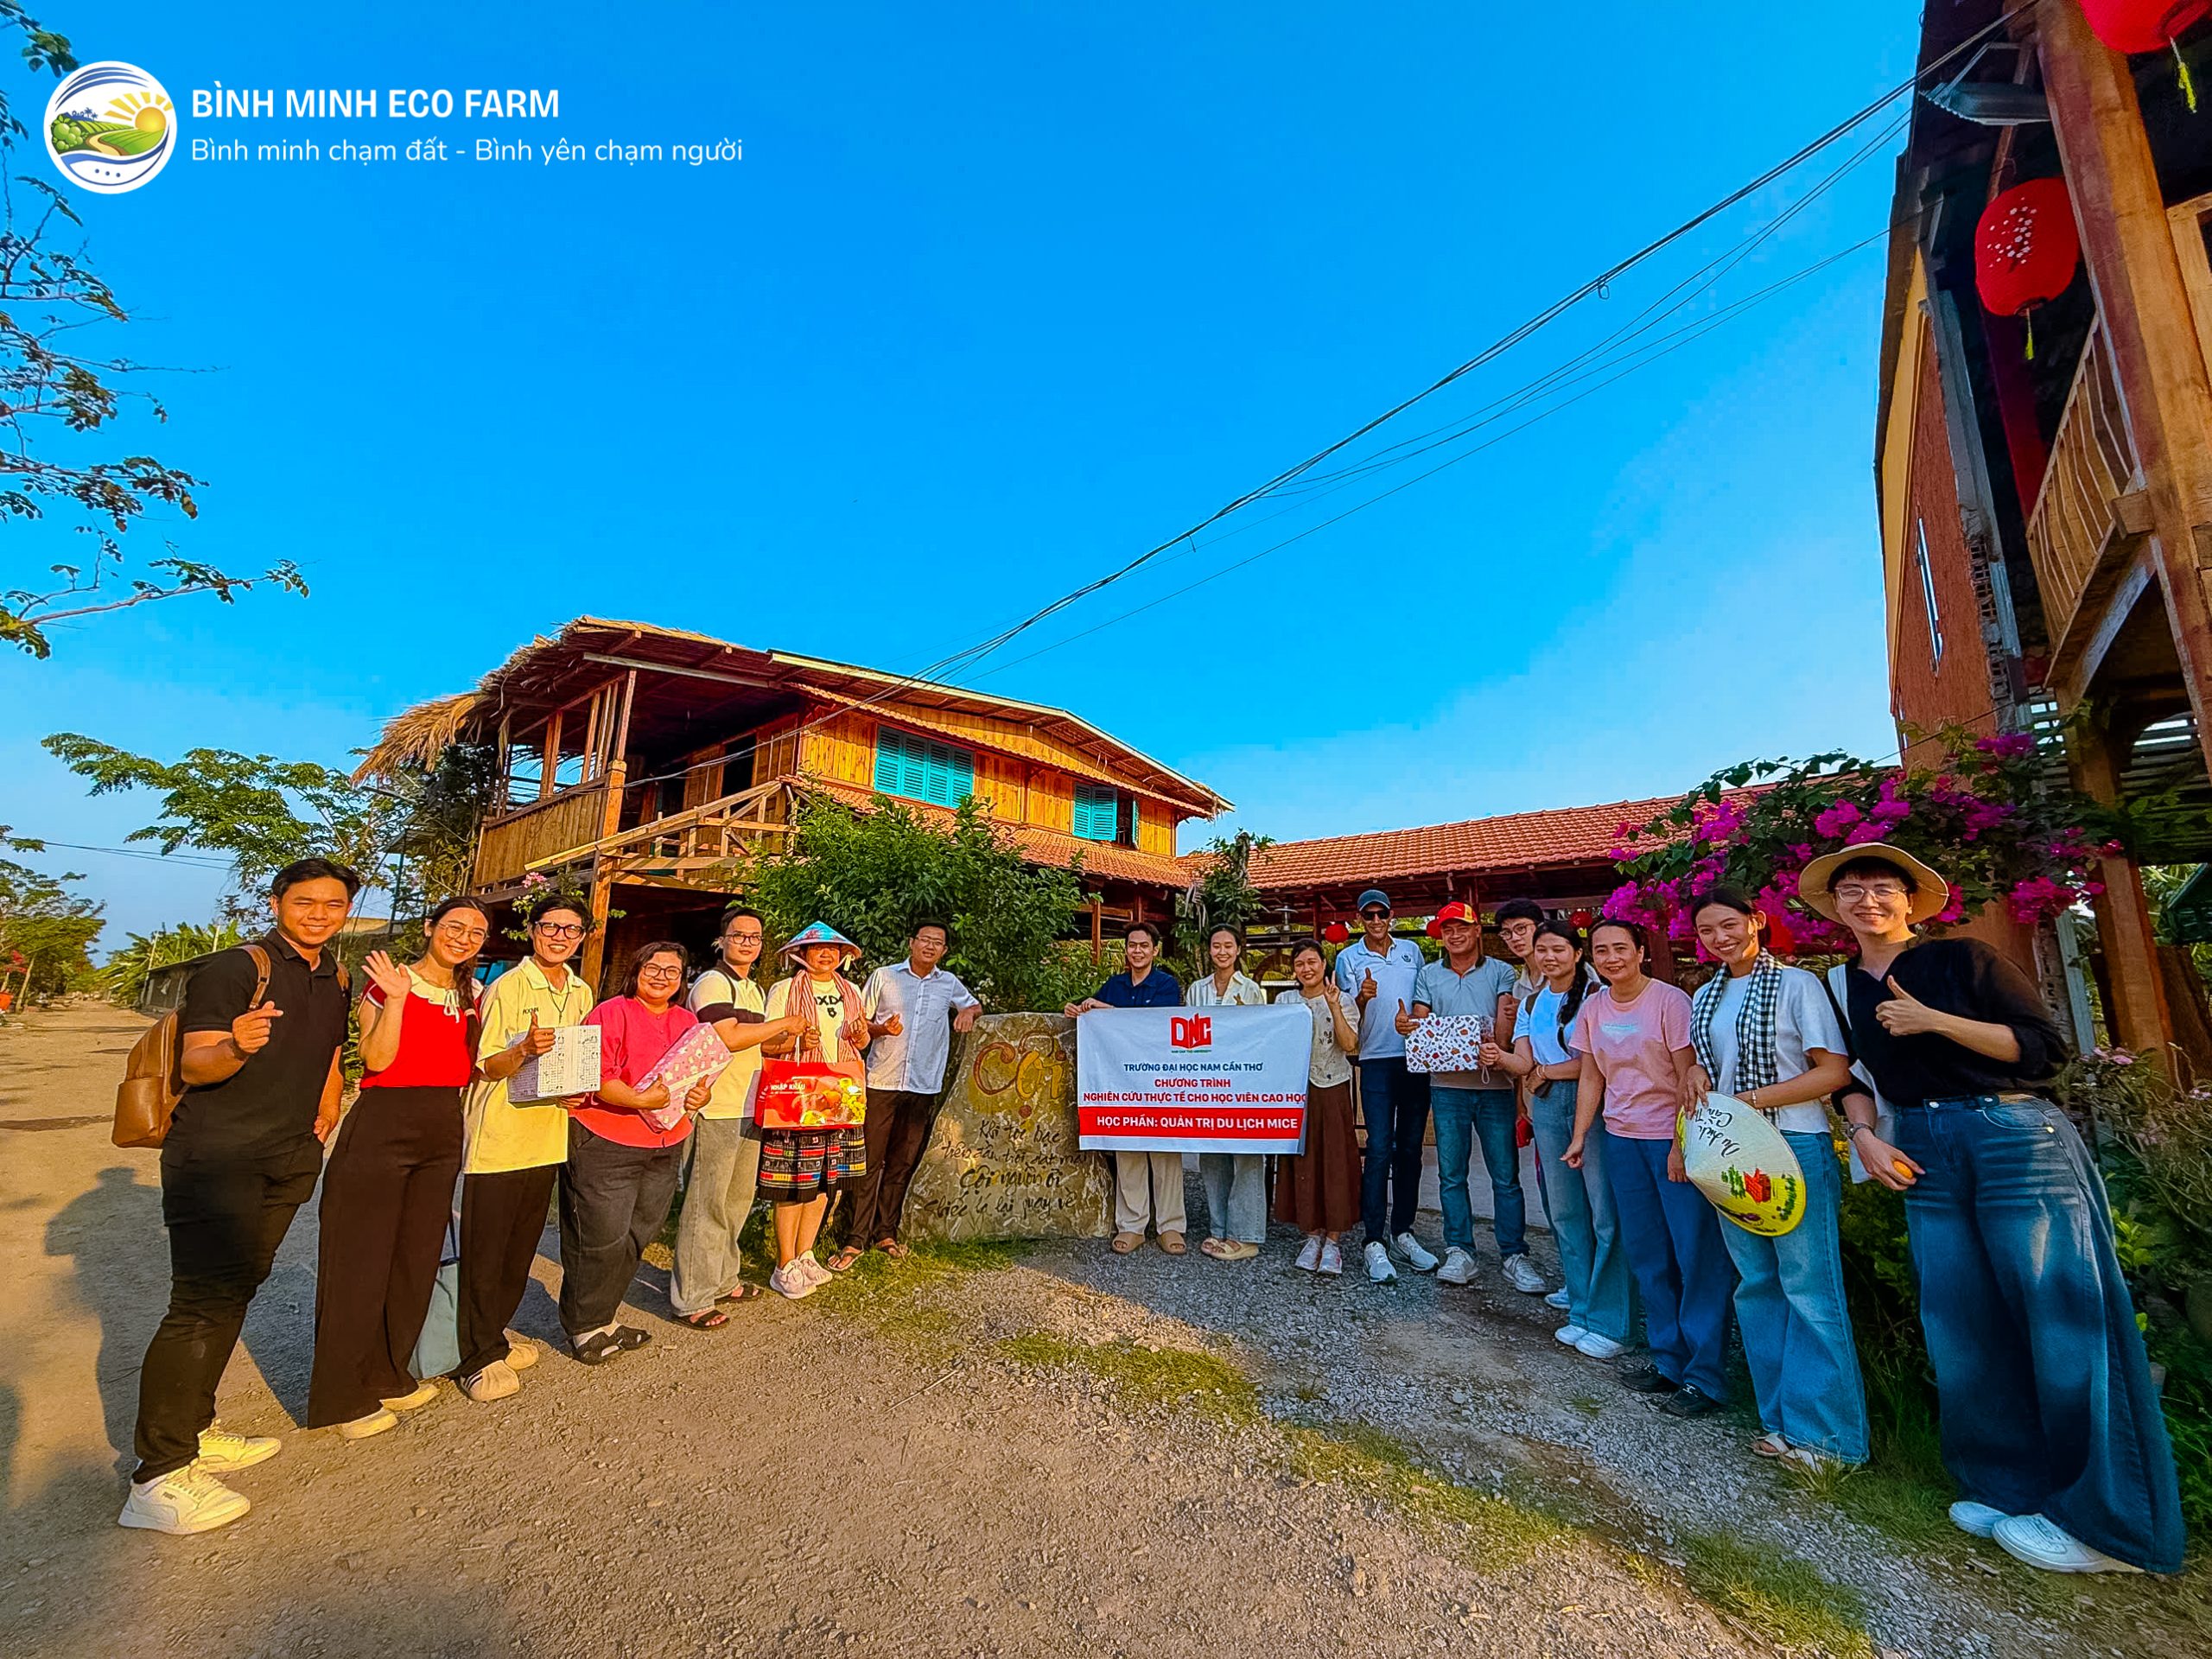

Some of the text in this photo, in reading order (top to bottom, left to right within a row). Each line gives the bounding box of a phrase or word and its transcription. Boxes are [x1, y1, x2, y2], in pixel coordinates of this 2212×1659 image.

[1171, 1013, 1211, 1049] DNC
[1123, 1062, 1160, 1071] TRƯỜNG
[1162, 1063, 1177, 1073] ĐẠI
[1179, 1063, 1198, 1073] HỌC
[1200, 1063, 1221, 1071] NAM
[1243, 1062, 1263, 1071] THƠ
[1154, 1077, 1230, 1087] CHƯƠNG TRÌNH
[1084, 1091, 1119, 1101] NGHIÊN
[1122, 1090, 1142, 1102] CỨU
[1144, 1092, 1172, 1103] THỰC
[1173, 1090, 1185, 1102] TẾ
[1187, 1093, 1209, 1102] CHO
[1211, 1093, 1233, 1104] HỌC
[1235, 1092, 1259, 1102] VIÊN
[1262, 1093, 1283, 1103] CAO
[1096, 1116, 1121, 1128] HỌC
[1160, 1115, 1193, 1128] QUẢN
[1195, 1117, 1214, 1130] TRỊ
[1217, 1117, 1234, 1128] DU
[1236, 1118, 1264, 1131] LỊCH
[1267, 1118, 1298, 1129] MICE
